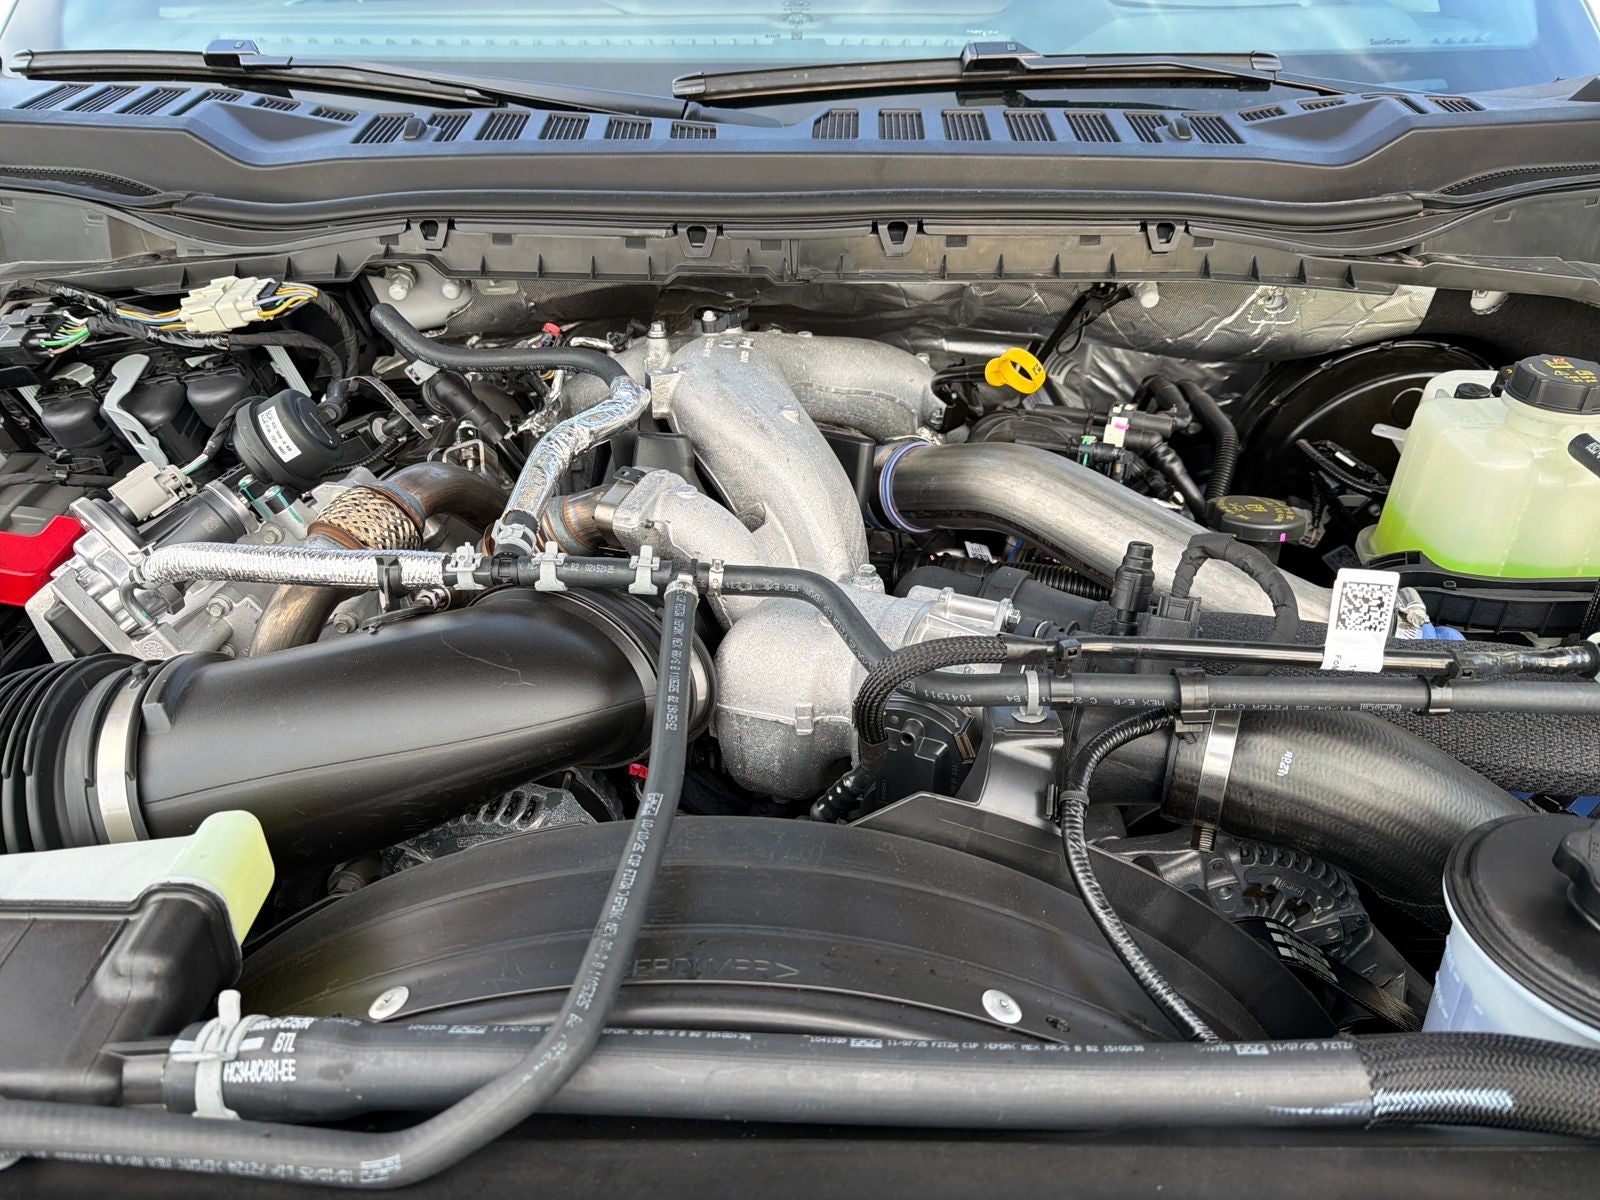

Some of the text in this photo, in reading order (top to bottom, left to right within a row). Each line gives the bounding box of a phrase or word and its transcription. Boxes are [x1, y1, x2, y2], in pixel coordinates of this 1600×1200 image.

[923, 688, 972, 703] 1041911
[1142, 698, 1165, 706] MEX
[271, 1032, 297, 1053] BTL
